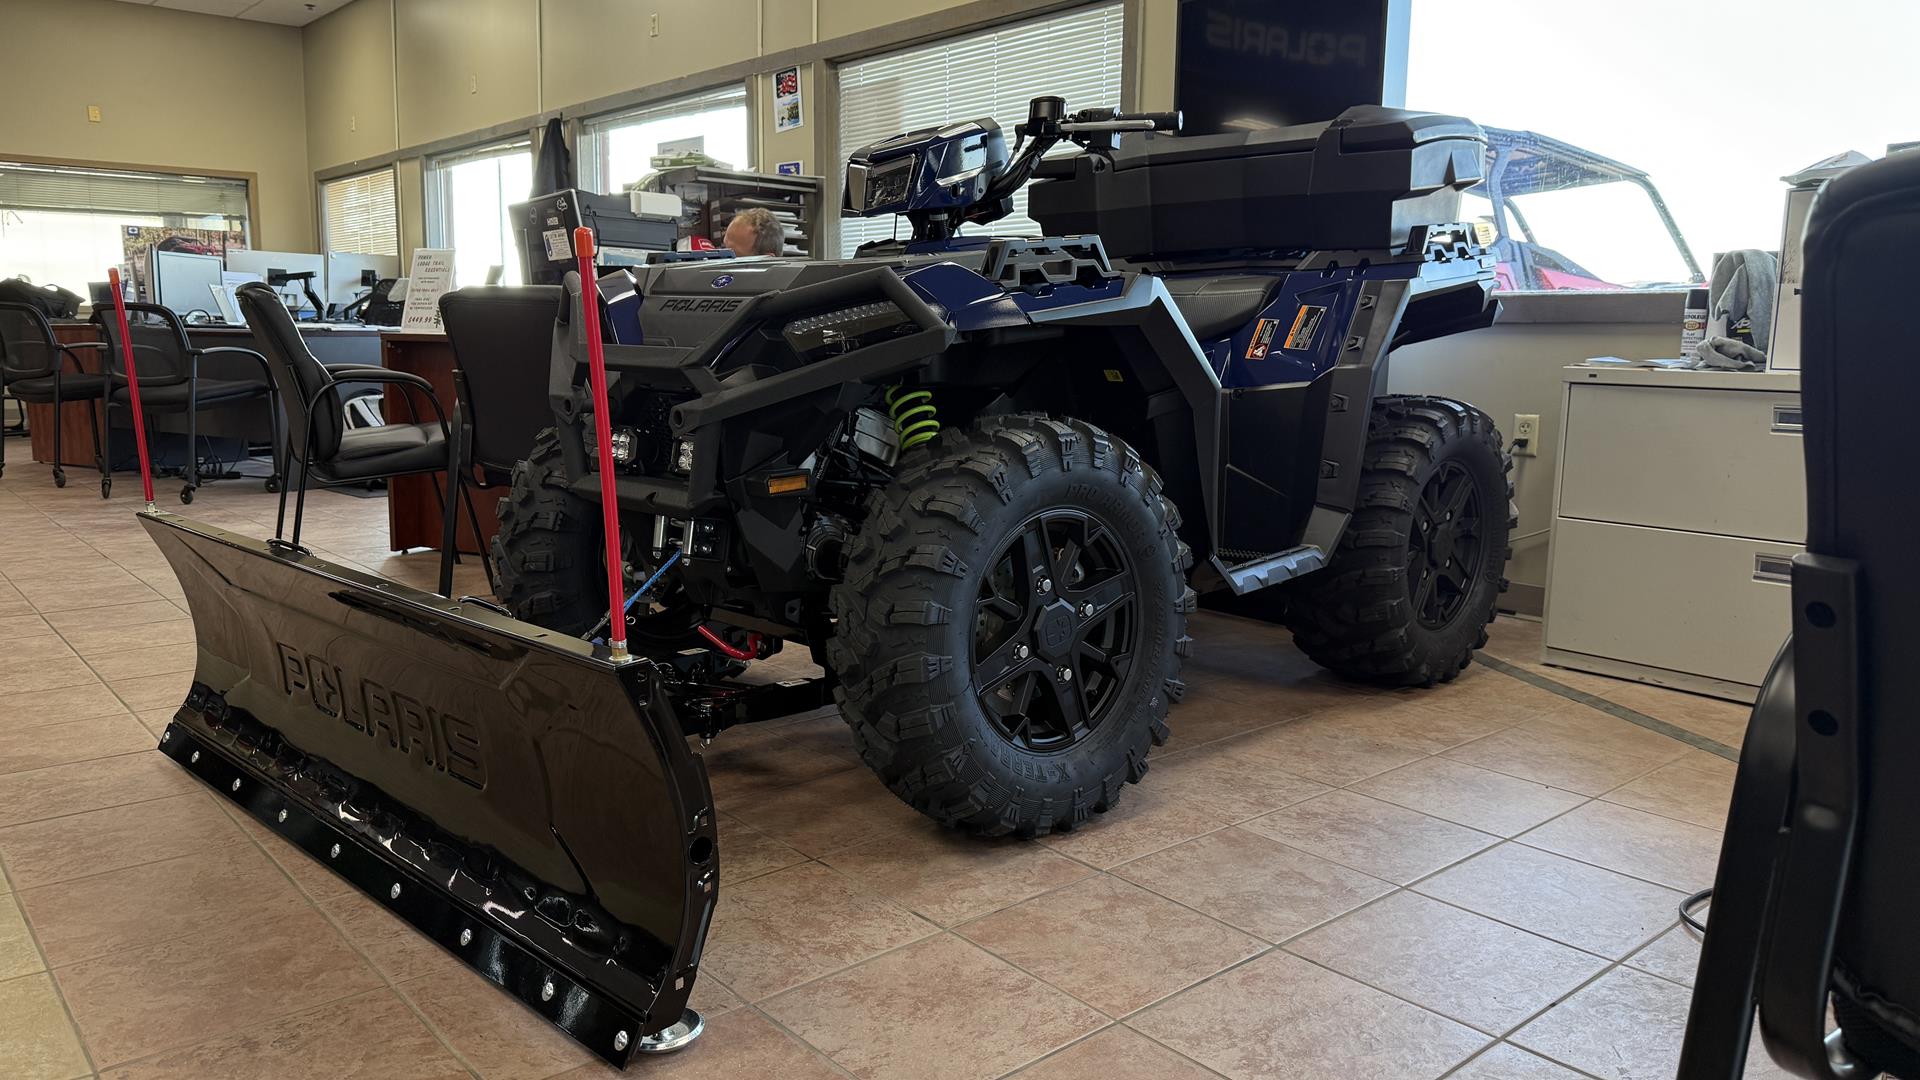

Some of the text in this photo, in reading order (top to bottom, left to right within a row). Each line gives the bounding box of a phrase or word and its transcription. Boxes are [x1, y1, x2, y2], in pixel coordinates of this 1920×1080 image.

[659, 299, 742, 313] POLARIS
[1065, 482, 1099, 500] PRO
[277, 641, 488, 791] POLARIS
